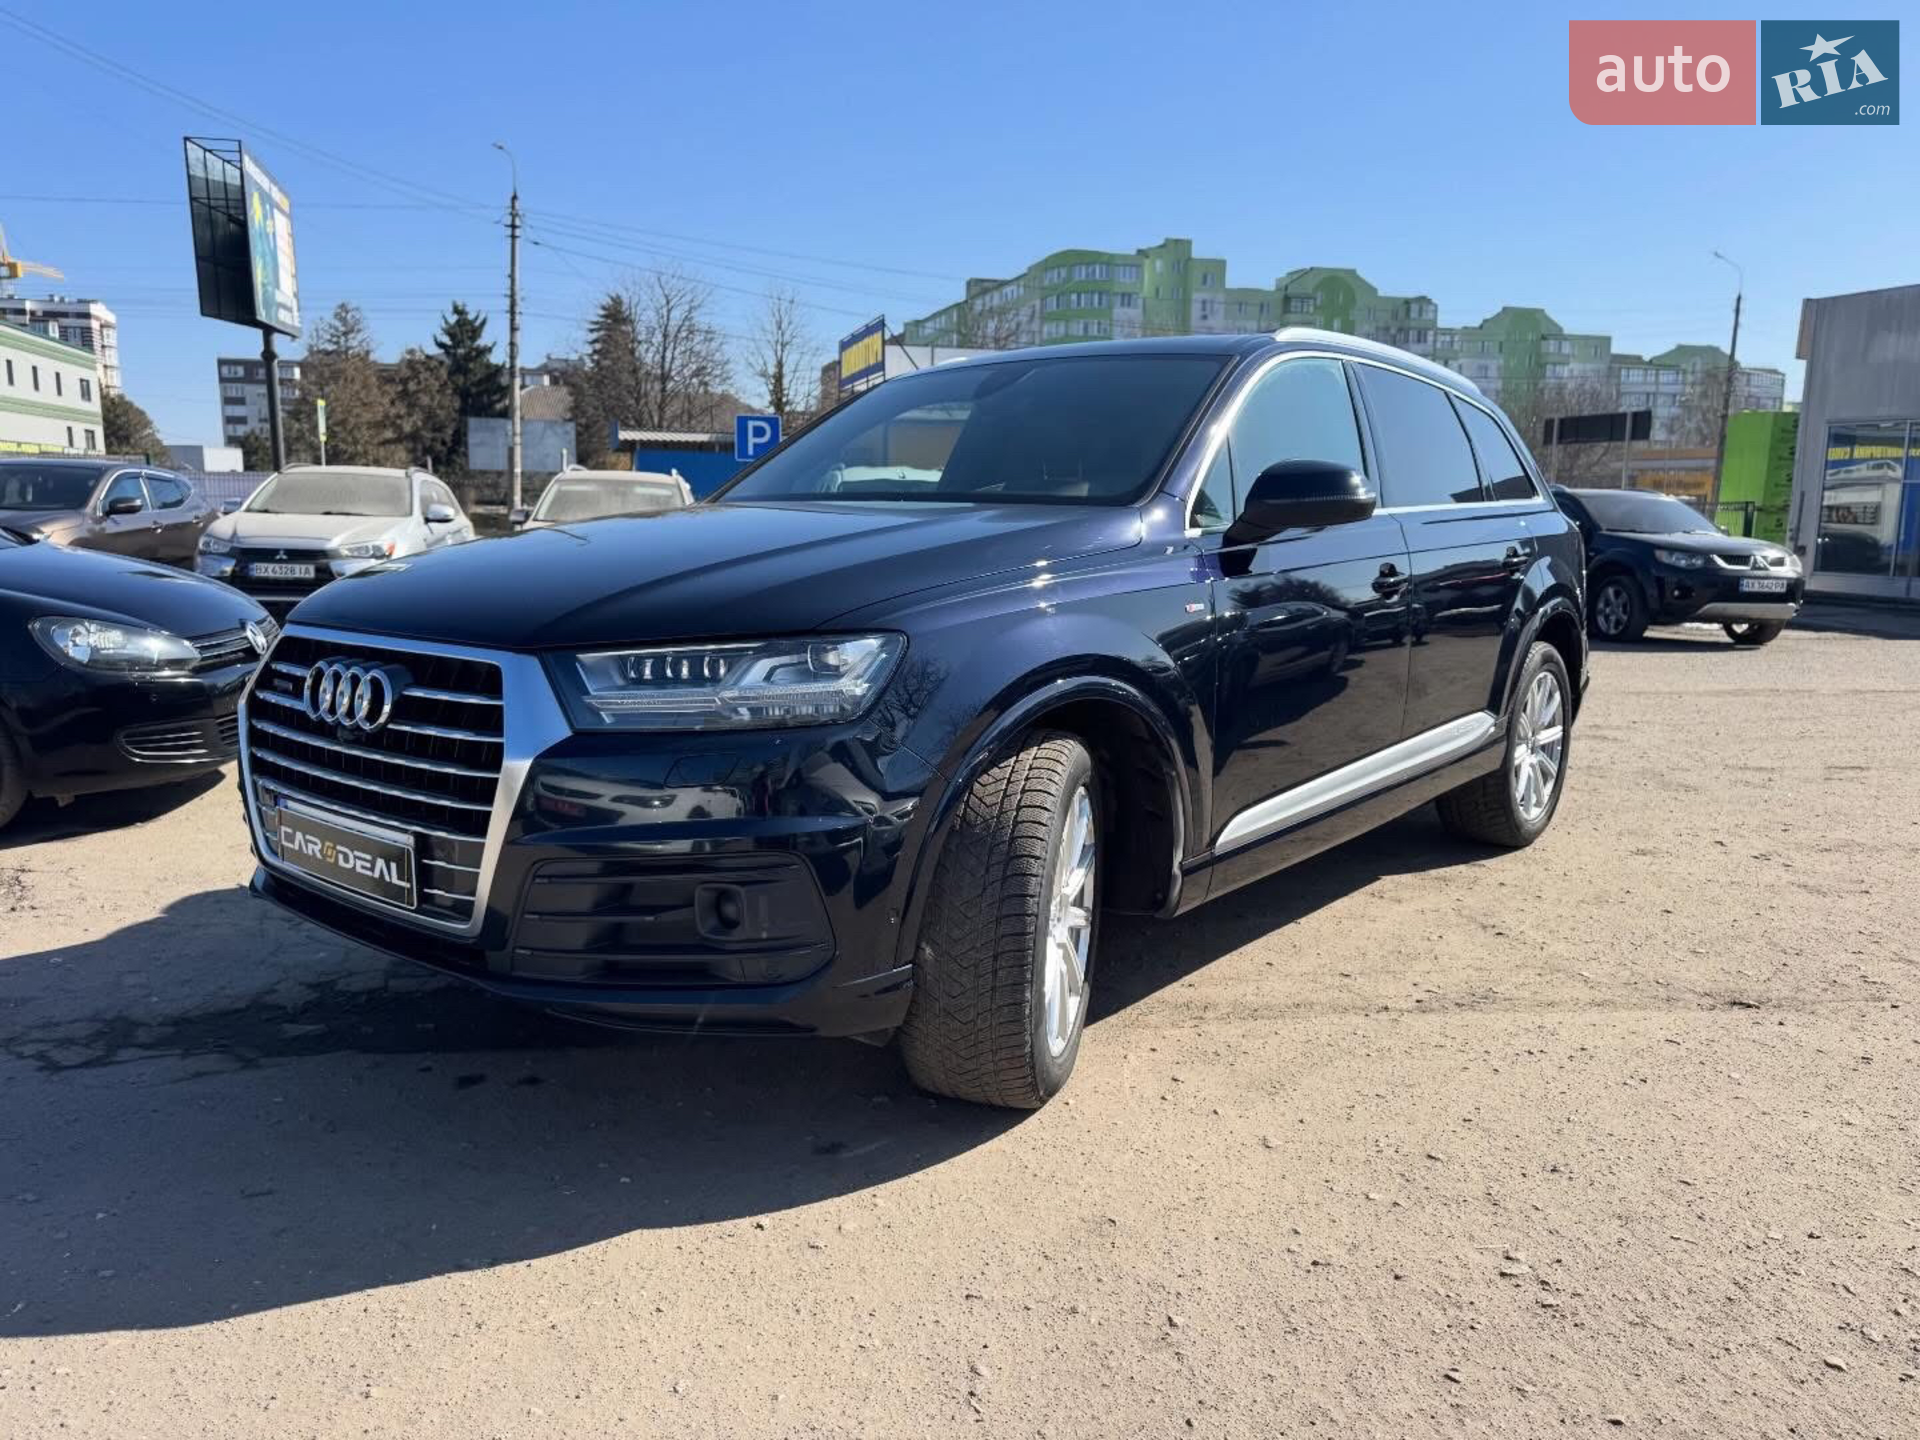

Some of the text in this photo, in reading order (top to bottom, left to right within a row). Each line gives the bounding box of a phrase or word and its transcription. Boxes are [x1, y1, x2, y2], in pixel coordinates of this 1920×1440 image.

[747, 420, 772, 456] P
[280, 825, 411, 889] CAR DEAL
